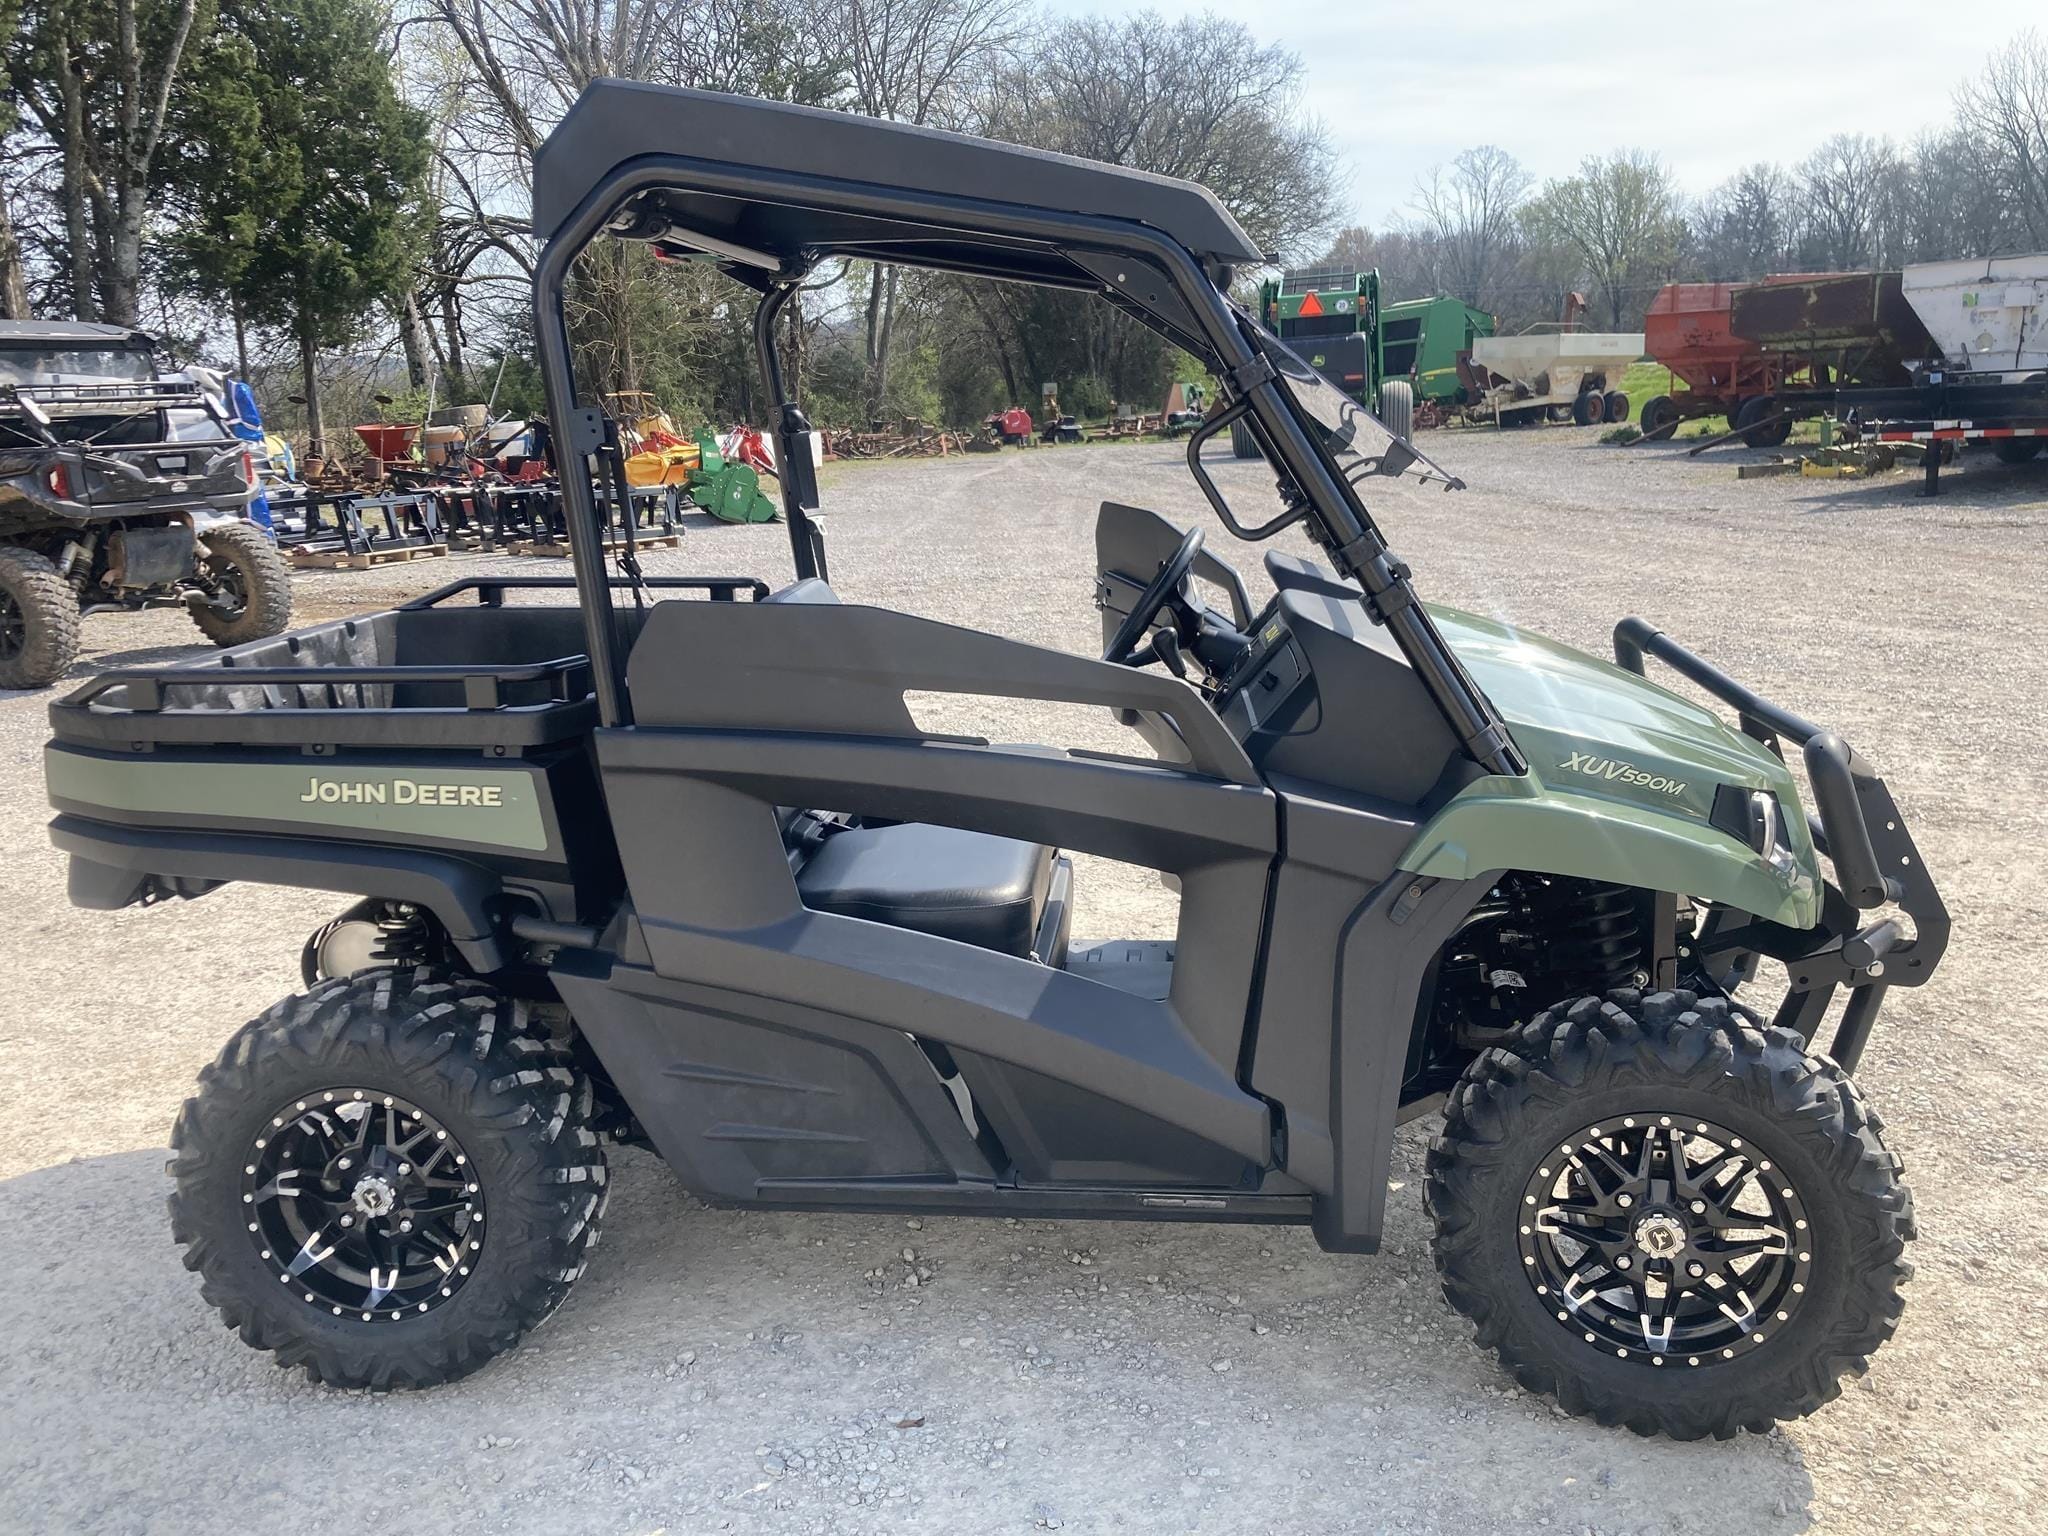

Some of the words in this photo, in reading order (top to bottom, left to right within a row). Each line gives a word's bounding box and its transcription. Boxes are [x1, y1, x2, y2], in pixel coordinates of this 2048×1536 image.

[300, 777, 386, 804] JOHN
[393, 779, 502, 807] DEERE
[1559, 750, 1687, 797] XUV590M
